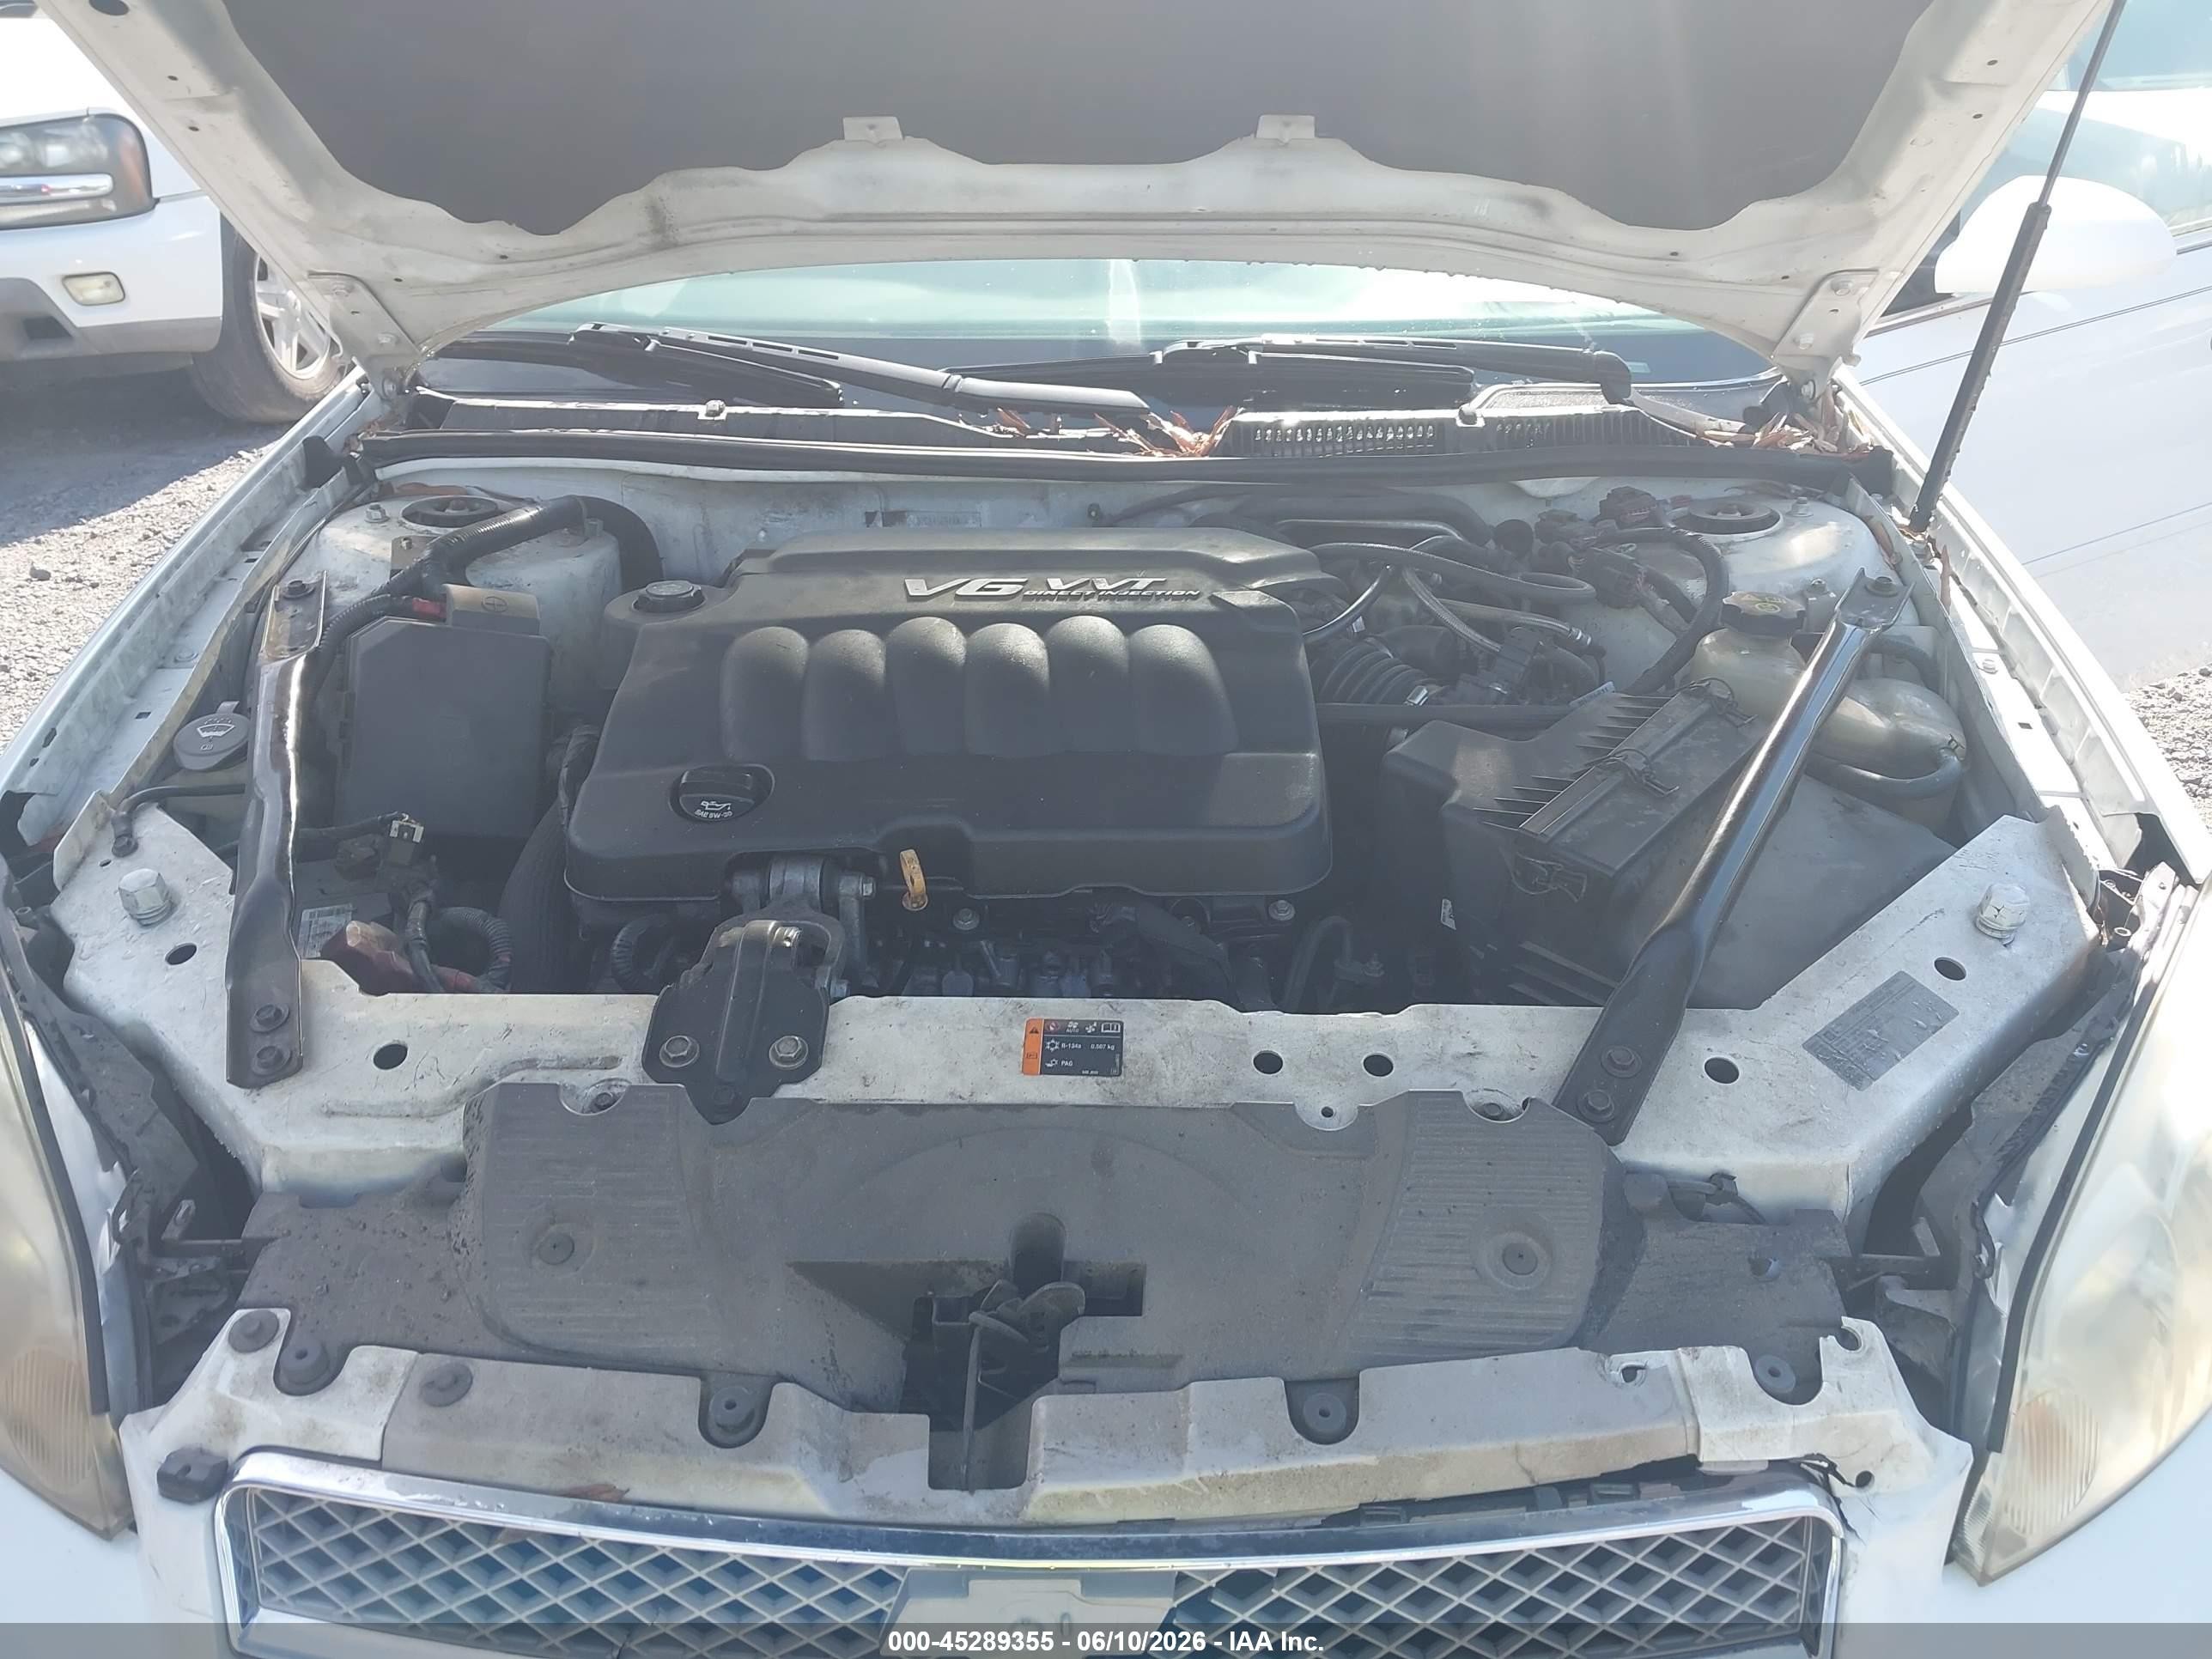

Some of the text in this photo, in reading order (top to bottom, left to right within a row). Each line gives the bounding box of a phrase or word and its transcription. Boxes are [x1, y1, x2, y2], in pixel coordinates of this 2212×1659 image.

[903, 577, 1168, 599] V6 VVT
[694, 810, 709, 818] SAE
